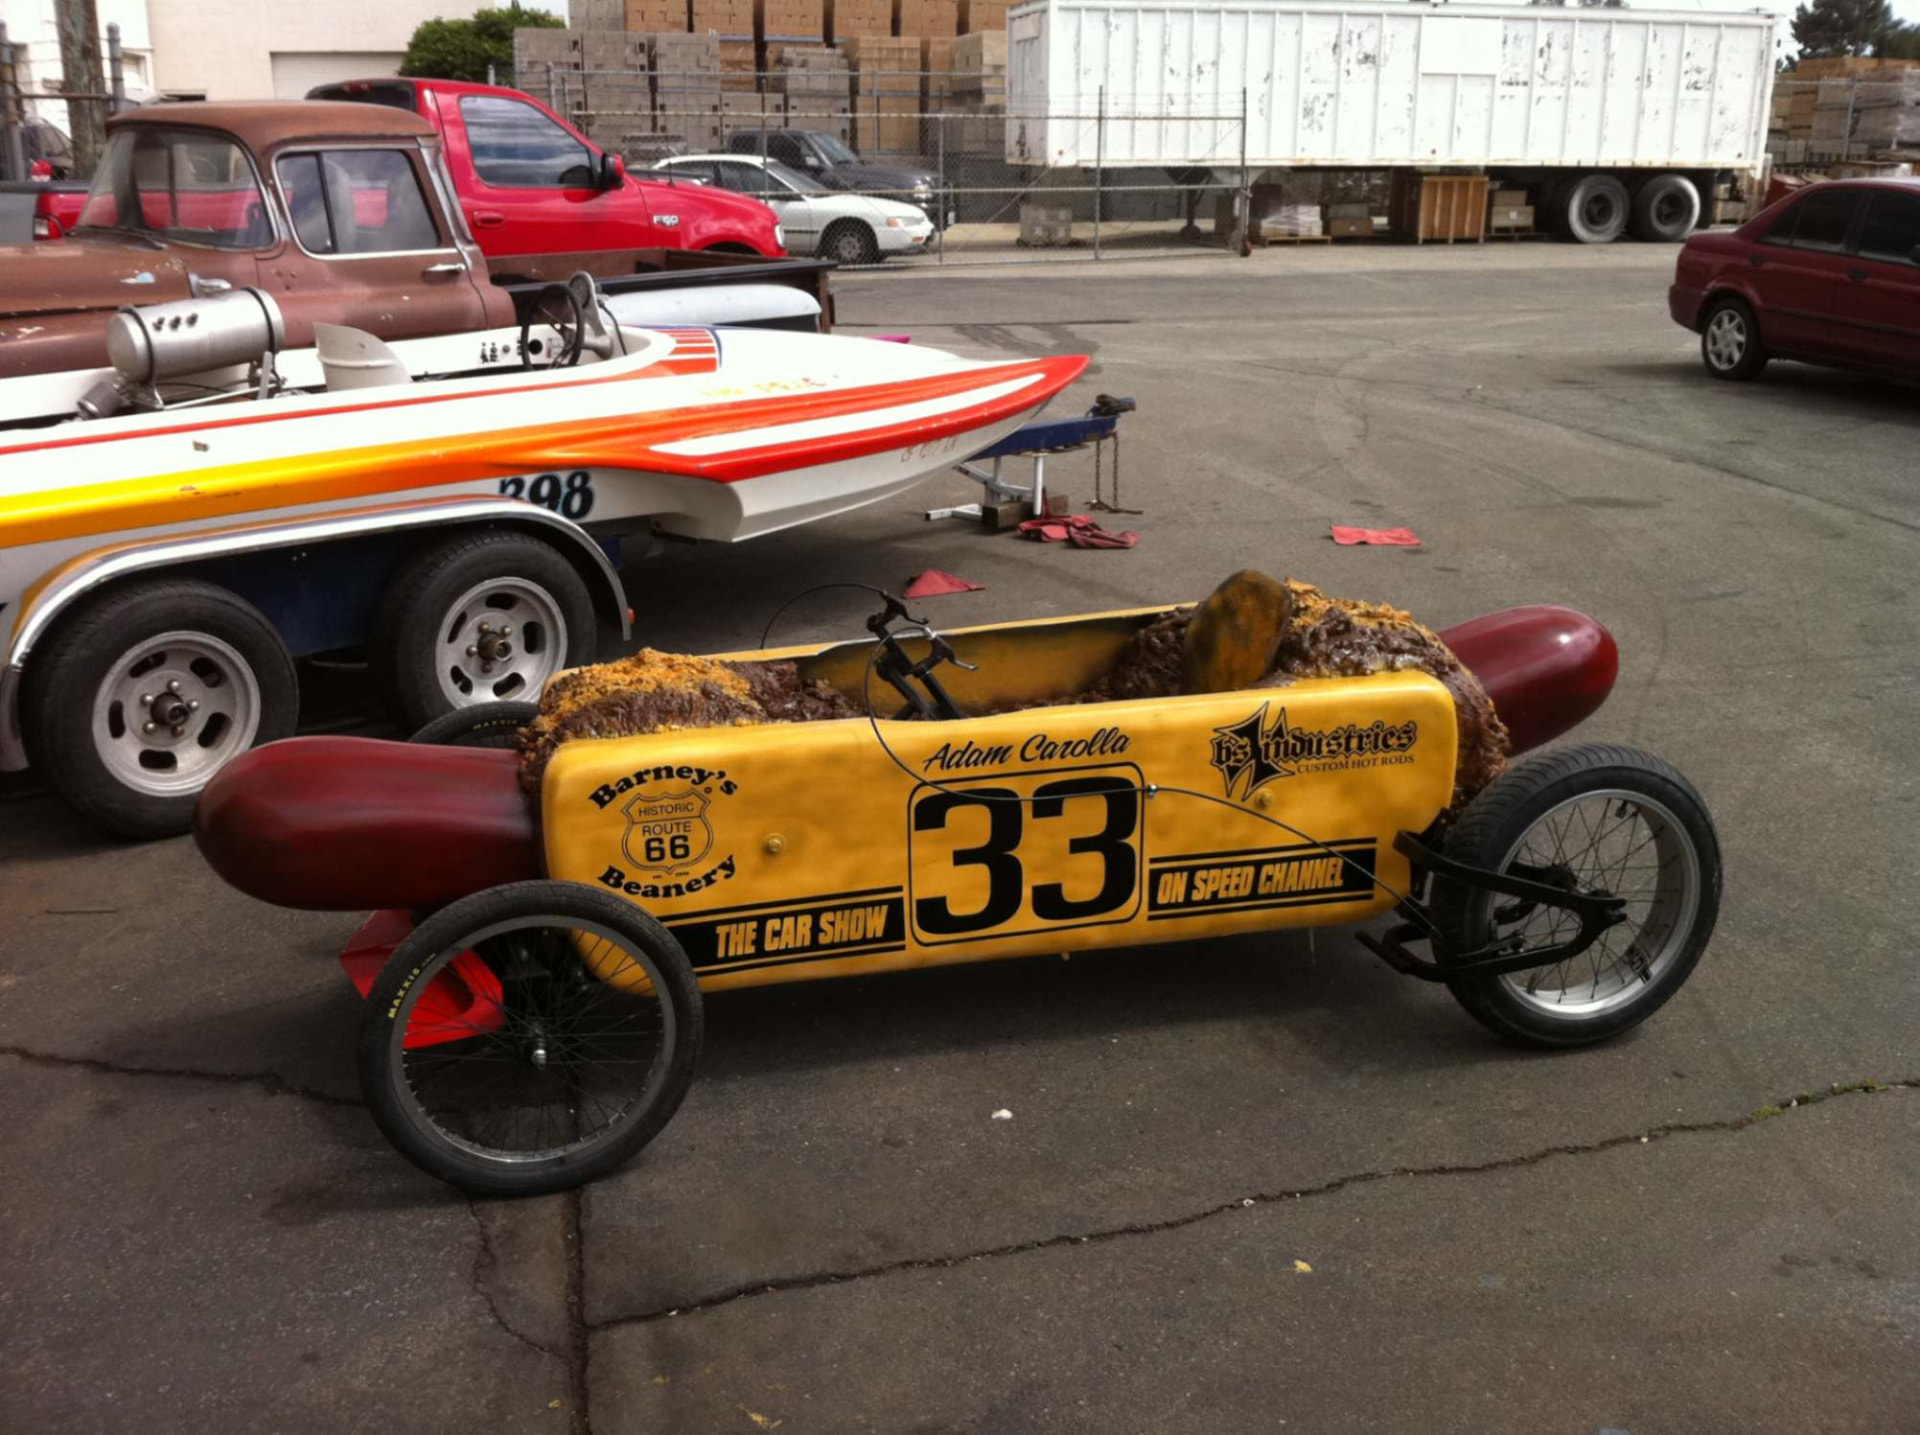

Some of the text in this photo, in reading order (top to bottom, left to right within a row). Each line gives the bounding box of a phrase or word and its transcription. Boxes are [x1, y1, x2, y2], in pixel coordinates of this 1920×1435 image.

[923, 727, 1130, 772] Adam Carolla
[1297, 753, 1415, 775] CUSTOM HOT RODS
[588, 765, 738, 809] Barney's
[638, 802, 695, 817] HISTORIC
[642, 821, 692, 837] ROUTE
[645, 835, 691, 862] 66
[914, 776, 1138, 934] 33
[597, 854, 736, 898] Beanery
[1157, 857, 1343, 904] ON SPEED CHANNEL
[716, 905, 889, 958] THE CAR SHOW
[388, 968, 420, 1018] MAXXIS
